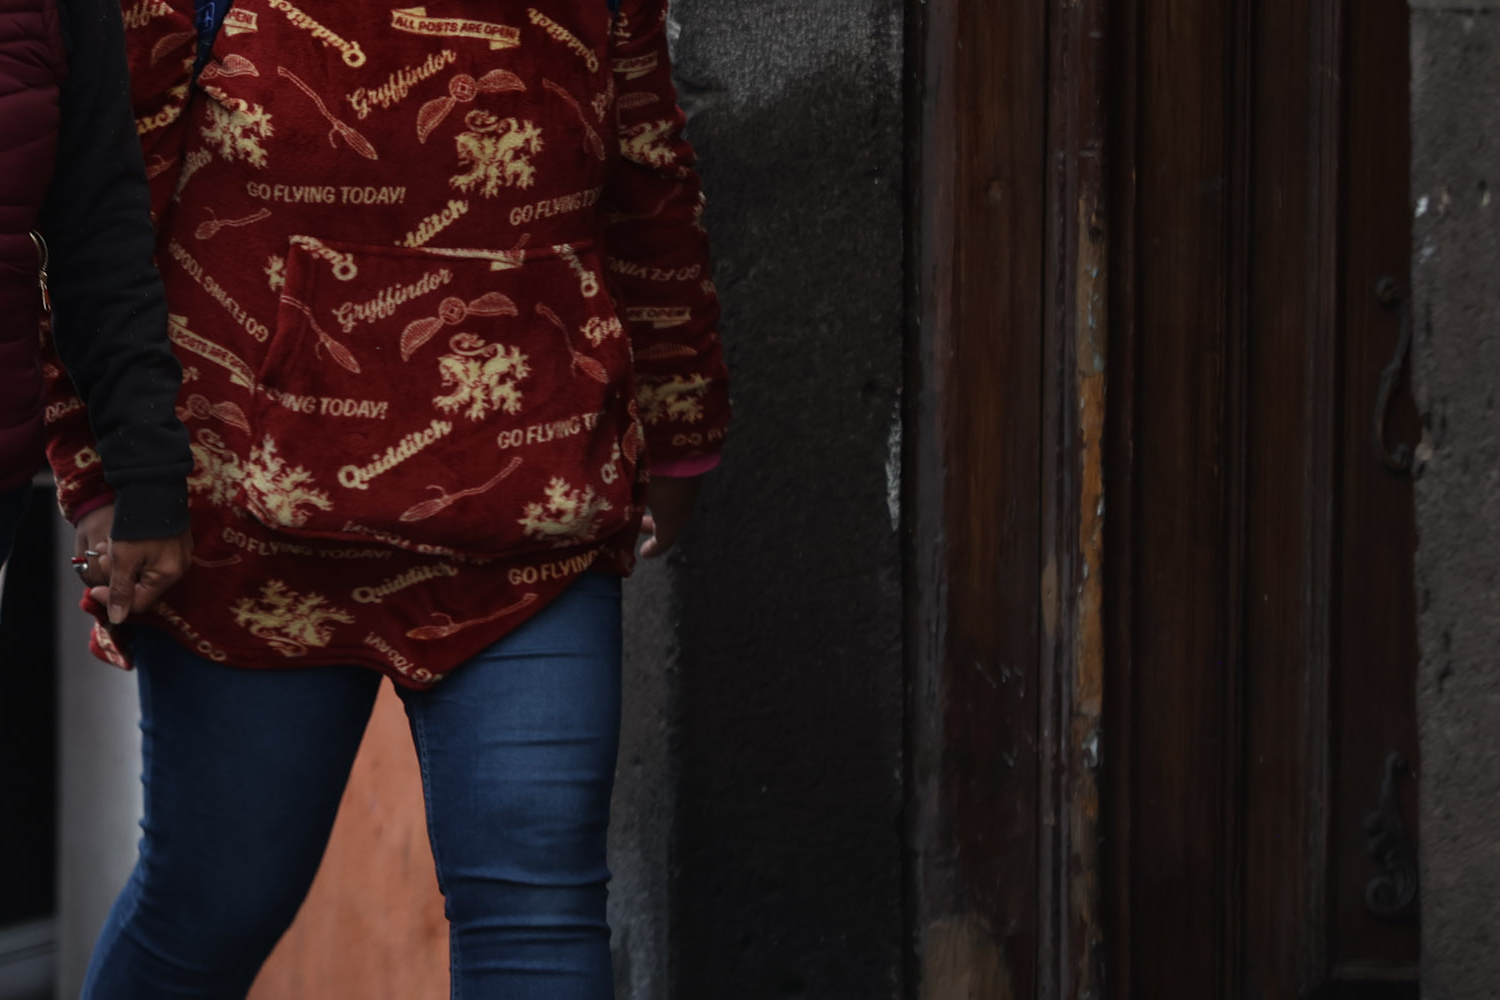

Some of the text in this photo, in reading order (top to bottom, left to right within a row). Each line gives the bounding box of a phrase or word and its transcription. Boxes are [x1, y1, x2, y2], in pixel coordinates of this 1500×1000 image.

[395, 16, 415, 29] ALL
[418, 21, 457, 33] POSTS
[460, 22, 482, 34] ARE
[345, 49, 457, 120] Gryffindor
[246, 181, 407, 205] GO FLYING TODAY!
[509, 204, 534, 227] GO
[332, 268, 453, 333] Gryffindor
[245, 317, 269, 343] GO
[320, 397, 389, 420] TODAY!
[497, 427, 524, 449] GO
[526, 409, 582, 444] FLYING
[337, 419, 453, 490] Quidditch
[223, 528, 247, 548] GO
[352, 562, 459, 604] Quidditch
[508, 567, 539, 586] GO
